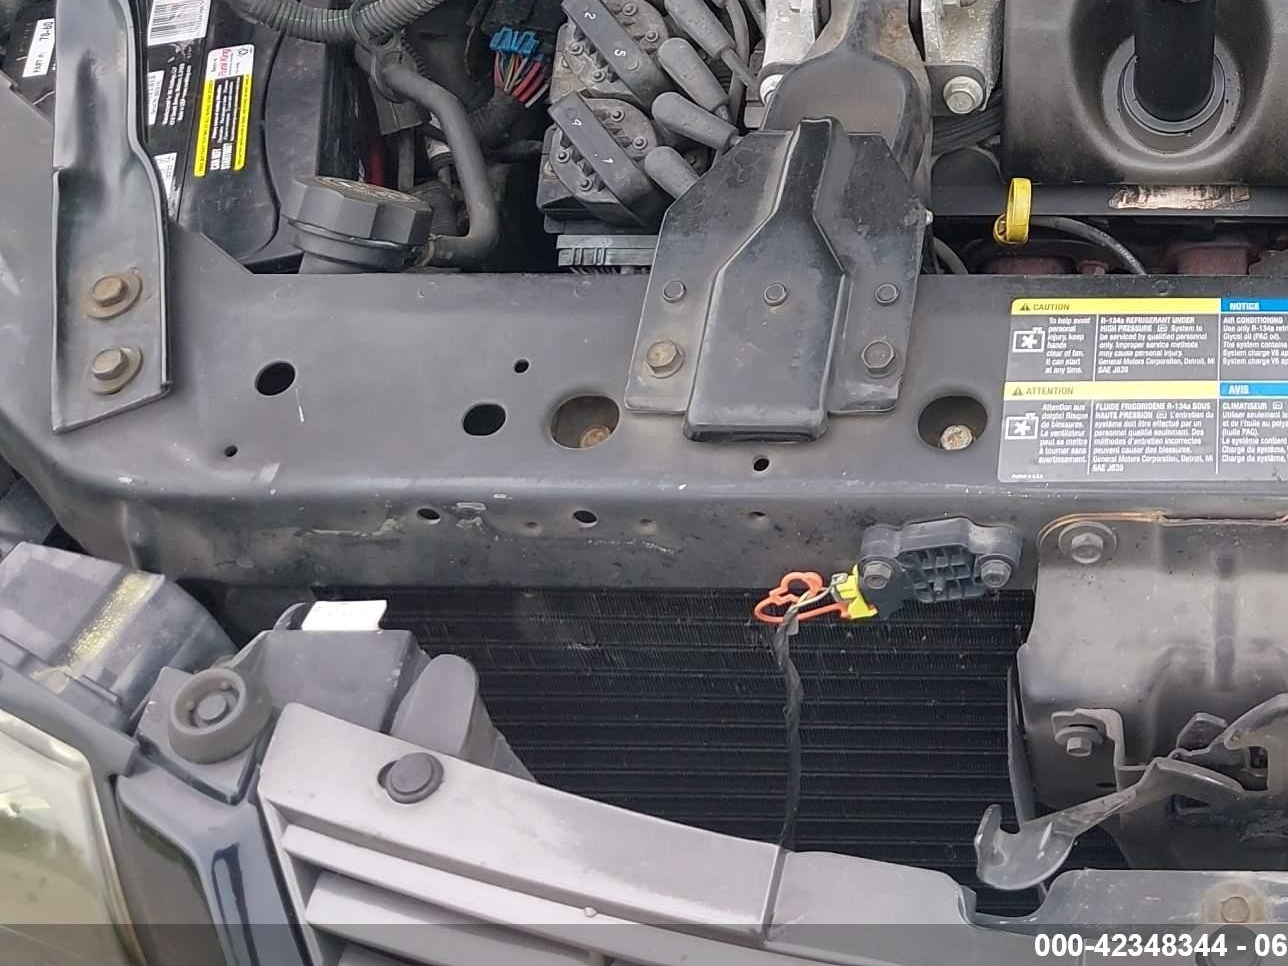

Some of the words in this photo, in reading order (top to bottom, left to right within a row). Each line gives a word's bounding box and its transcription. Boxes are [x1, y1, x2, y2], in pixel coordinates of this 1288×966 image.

[584, 12, 596, 21] 2
[614, 49, 626, 58] 5
[1026, 387, 1073, 395] ATTENTION
[1229, 385, 1249, 394] AVIS
[1095, 402, 1119, 410] FLUIDE
[1093, 455, 1117, 463] General
[1119, 455, 1140, 463] Motors
